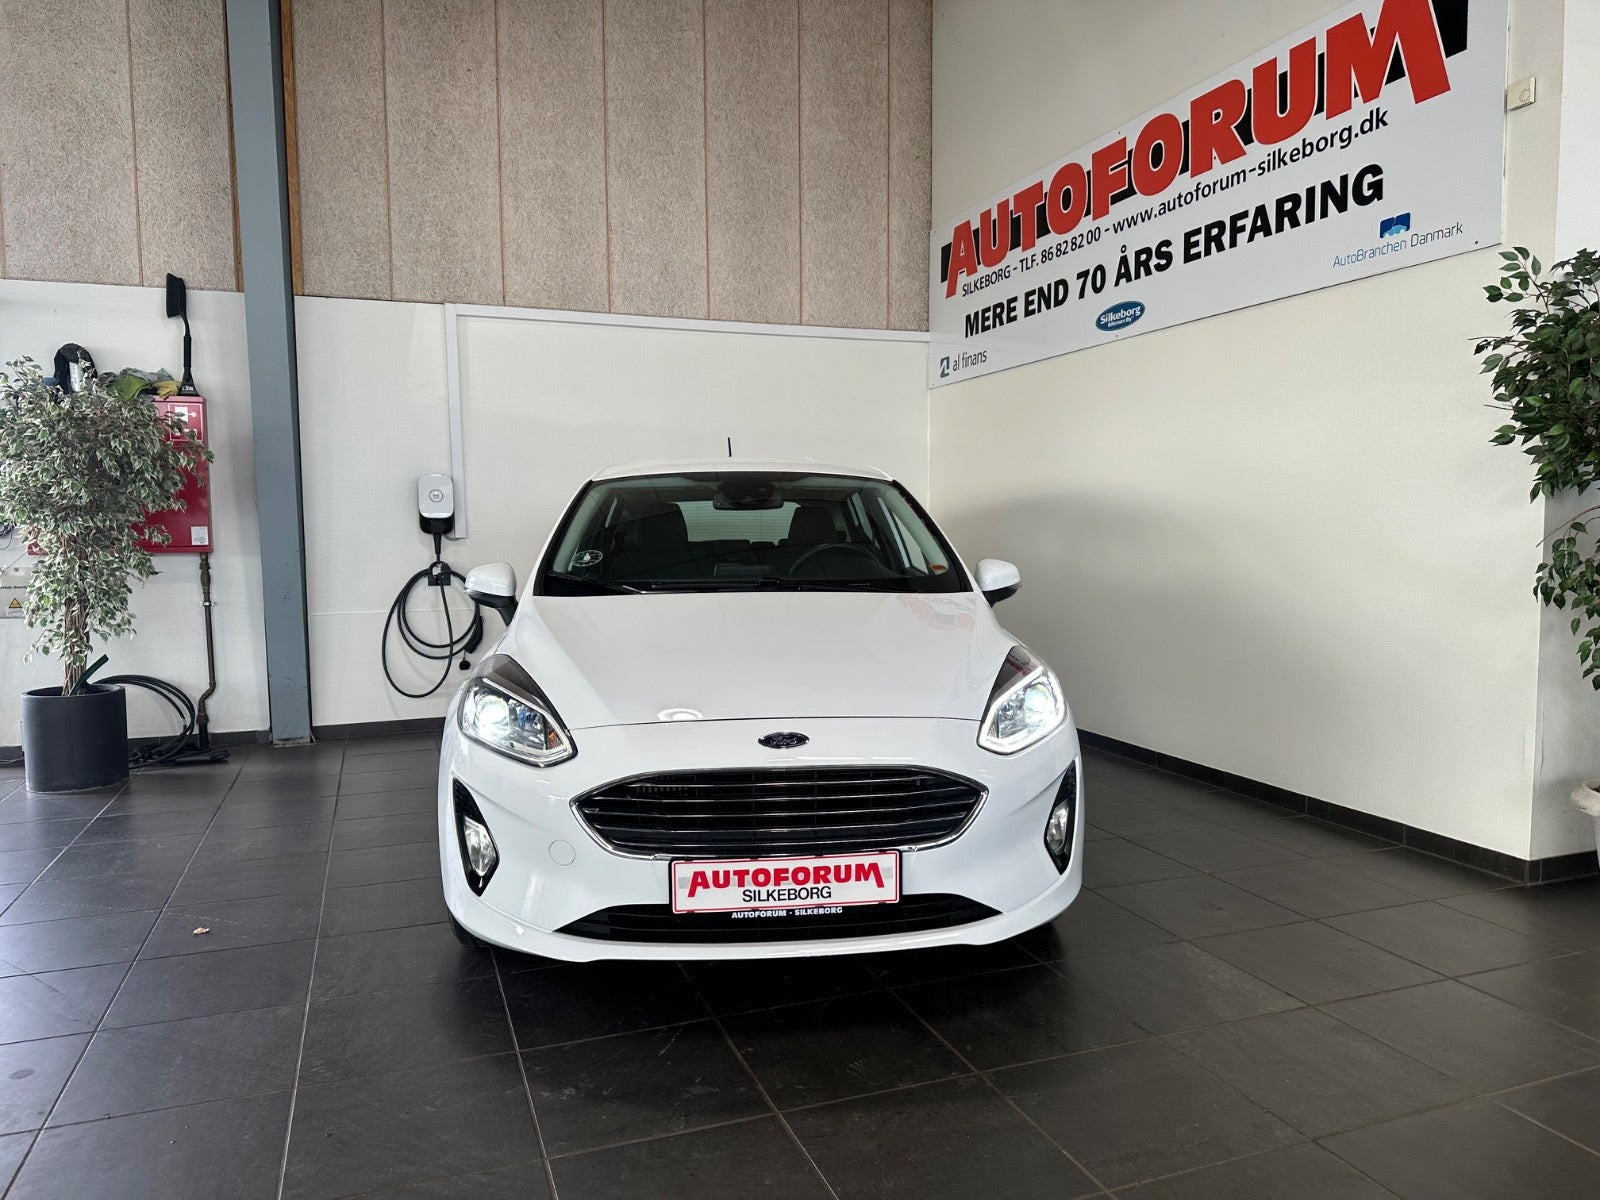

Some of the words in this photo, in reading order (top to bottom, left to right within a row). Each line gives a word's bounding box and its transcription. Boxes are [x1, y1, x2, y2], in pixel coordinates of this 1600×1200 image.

[945, 0, 1451, 299] AUTOFORUM
[962, 264, 1011, 297] SILKEBORG
[1019, 253, 1039, 273] TLF.
[1112, 107, 1389, 235] www.autoforum-silkeborg.dk
[965, 295, 1018, 339] MERE
[1024, 278, 1069, 318] END
[1076, 263, 1106, 300] 70
[1114, 244, 1173, 288] ÅRS
[1183, 163, 1384, 264] ERFARING
[1332, 239, 1407, 268] AutoBranchen
[1410, 222, 1463, 248] Danmark
[1100, 306, 1141, 325] Silkeborg
[952, 354, 960, 372] al
[961, 350, 988, 367] finans
[687, 862, 885, 898] AUTOFORUM
[742, 886, 832, 903] SILKEBORG
[731, 908, 787, 919] AUTOFORUM
[794, 906, 843, 917] SILKEBORG
